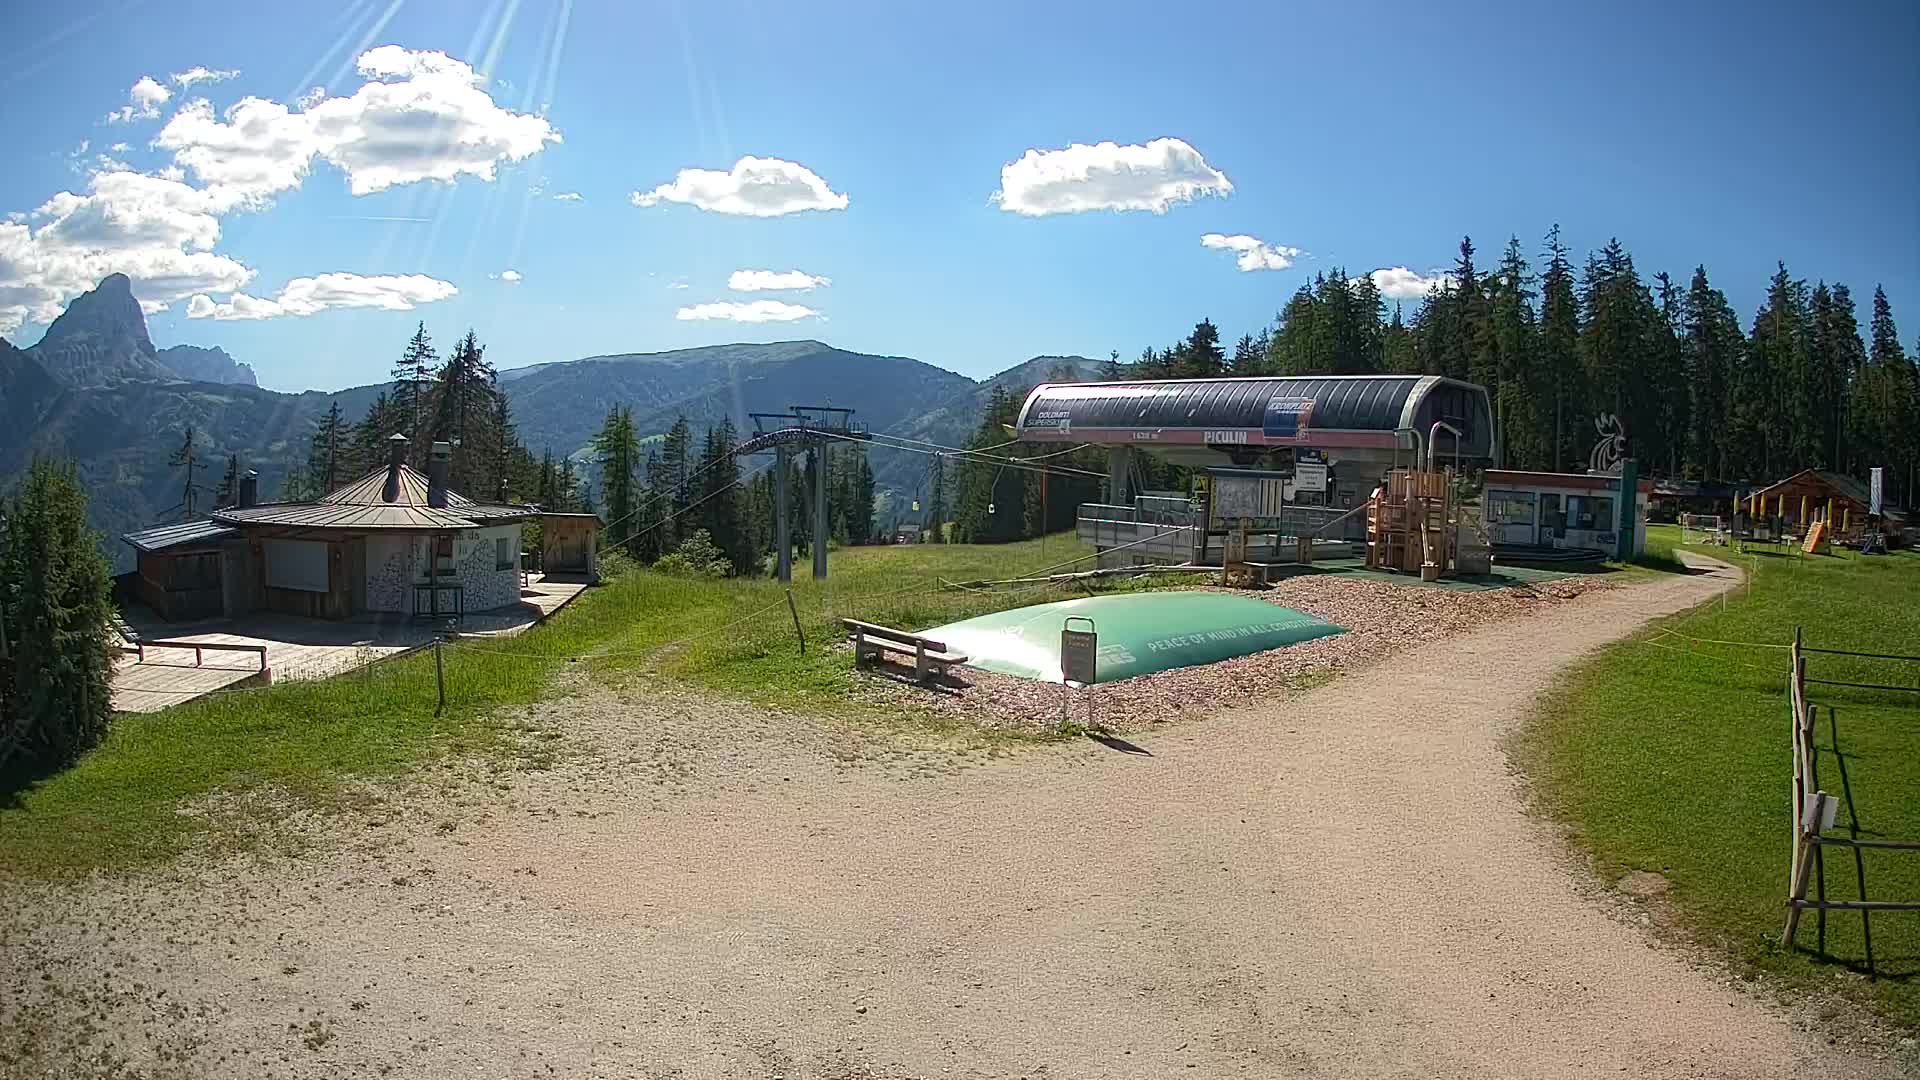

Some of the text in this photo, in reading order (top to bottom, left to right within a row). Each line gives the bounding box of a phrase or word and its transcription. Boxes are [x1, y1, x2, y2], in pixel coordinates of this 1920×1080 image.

[1204, 431, 1247, 444] PICULIN
[1147, 636, 1190, 653] PEACE
[1191, 632, 1208, 645] OF
[1207, 629, 1238, 642] MIND
[1238, 626, 1252, 637] IN
[1252, 624, 1272, 635] ALL
